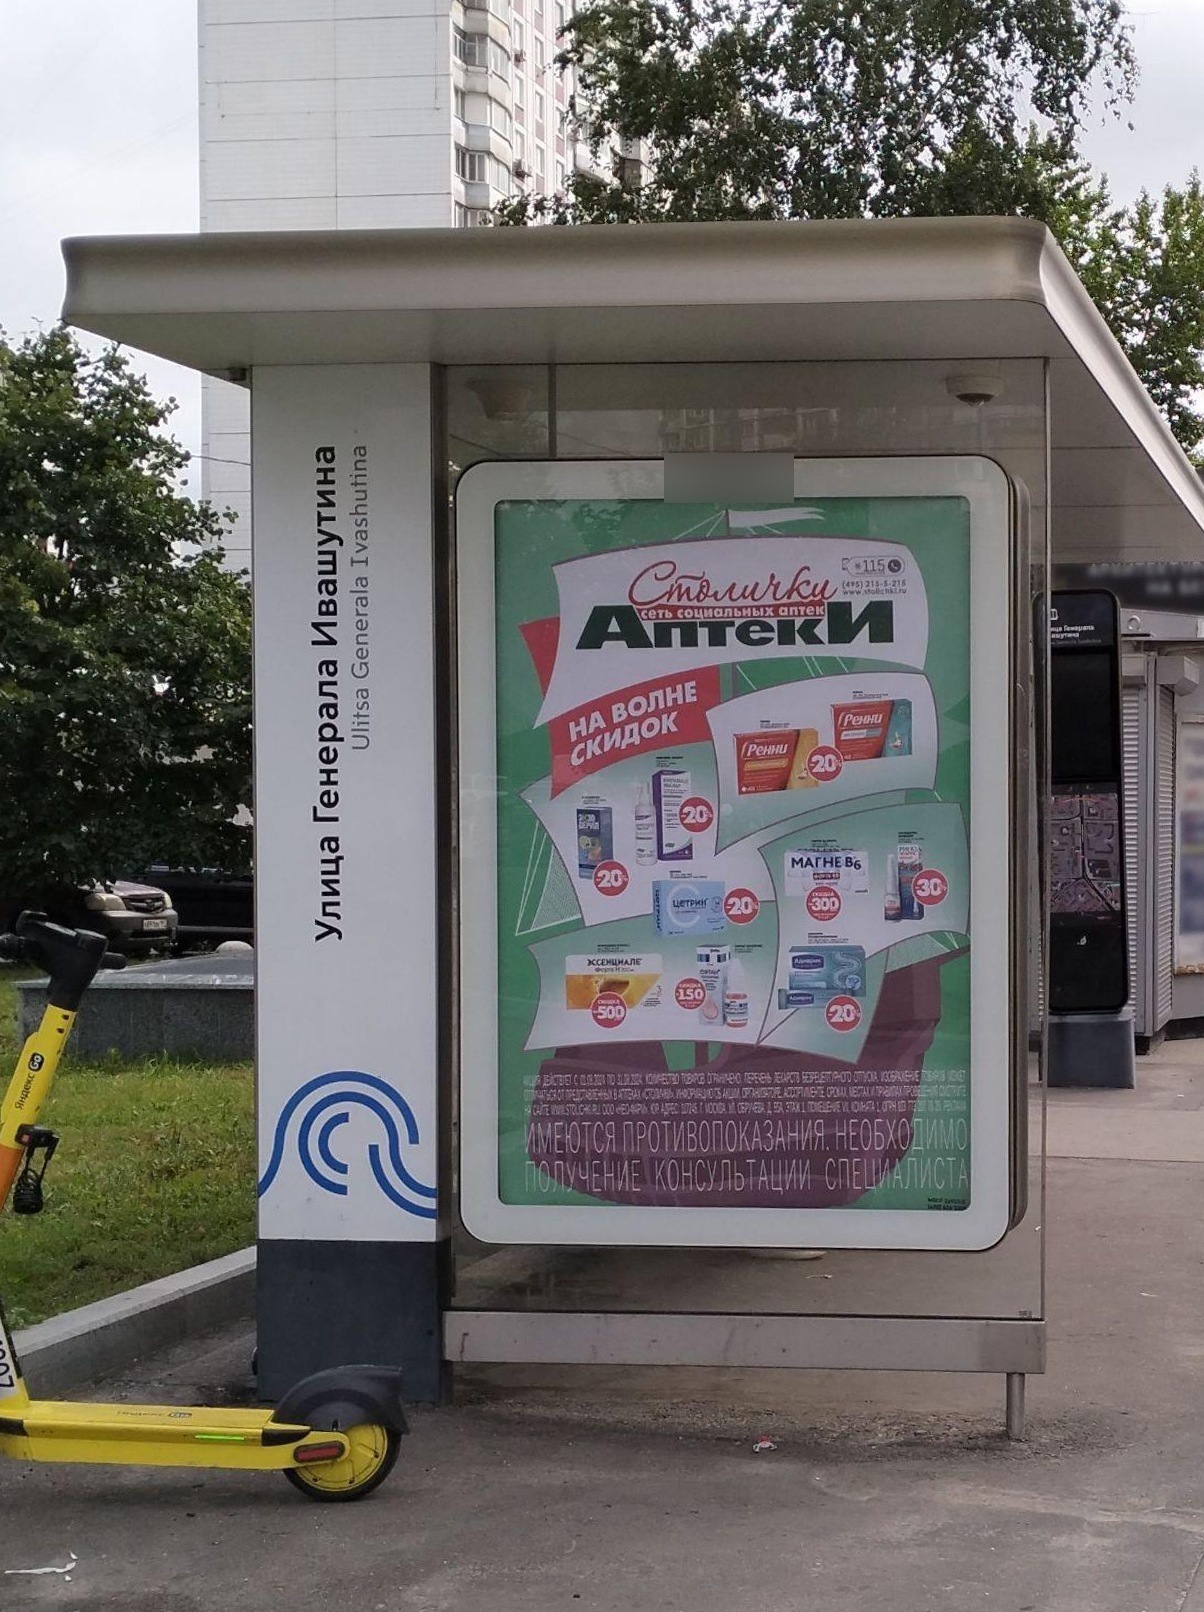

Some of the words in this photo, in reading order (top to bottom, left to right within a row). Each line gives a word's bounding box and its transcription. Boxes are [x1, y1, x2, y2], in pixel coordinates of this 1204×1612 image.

[350, 445, 370, 567] Ivashutina
[311, 445, 344, 647] Ивашутина
[627, 559, 839, 605] Столички
[350, 572, 371, 679] Generala
[640, 607, 674, 620] сеть
[676, 604, 775, 619] социальных
[778, 603, 825, 617] аптек
[351, 686, 371, 750] Ulitsa
[568, 712, 606, 743] НА
[611, 680, 700, 723] ВОЛНЕ
[844, 712, 883, 727] Ренни
[313, 659, 345, 823] Генерала
[569, 715, 679, 768] СКИДОК
[747, 742, 788, 757] Ренни
[791, 856, 842, 869] МАГНЕ
[314, 838, 343, 943] Улица
[524, 1120, 617, 1154] ИМЕЮТСЯ
[622, 1119, 830, 1153] ПРОТИВОПОКАЗАНИЯ.
[835, 1118, 968, 1155] НЕОБХОДИМО
[524, 1160, 642, 1193] ПОЛУЧЕНИЕ
[655, 1158, 812, 1195] КОНСУЛЬТАЦИИ
[825, 1157, 970, 1193] СПЕЦИАЛИСТА
